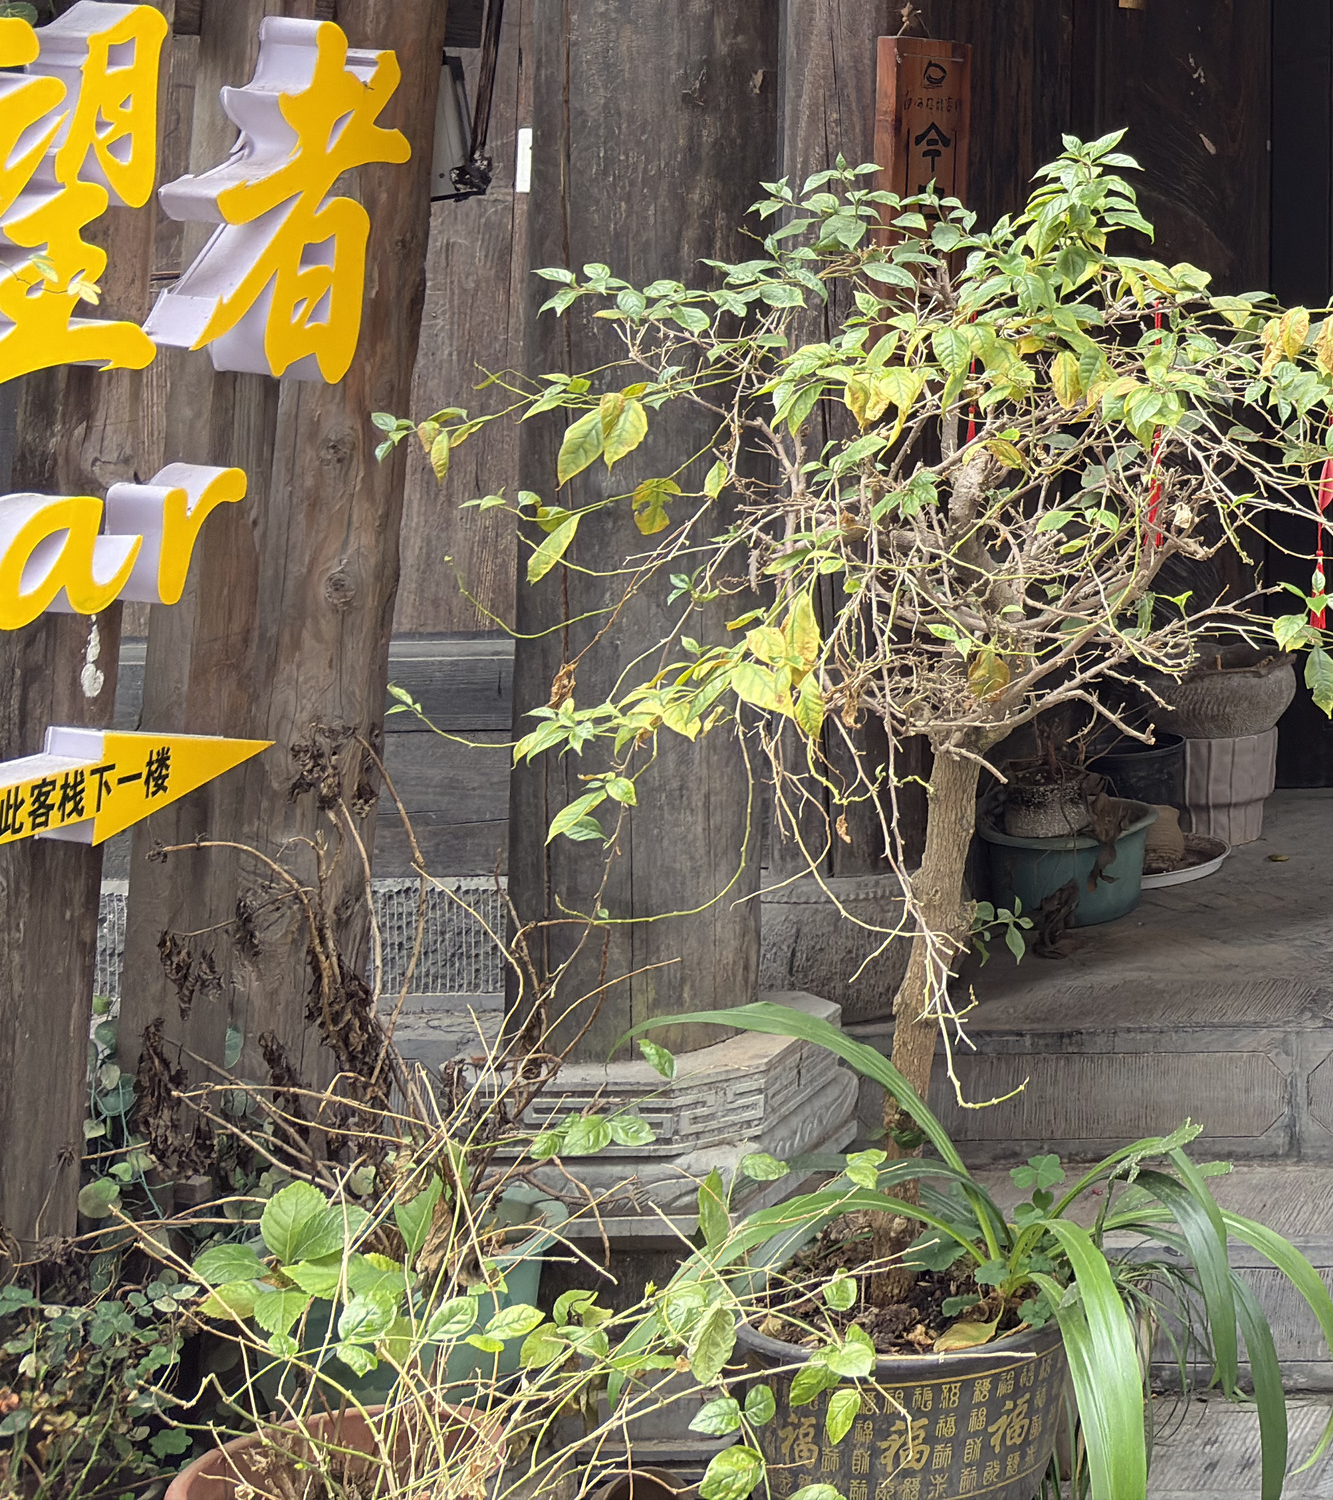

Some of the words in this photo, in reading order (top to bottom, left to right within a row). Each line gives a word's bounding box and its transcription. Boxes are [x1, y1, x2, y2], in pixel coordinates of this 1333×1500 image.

[0, 746, 171, 837] 此客栈下一楼
